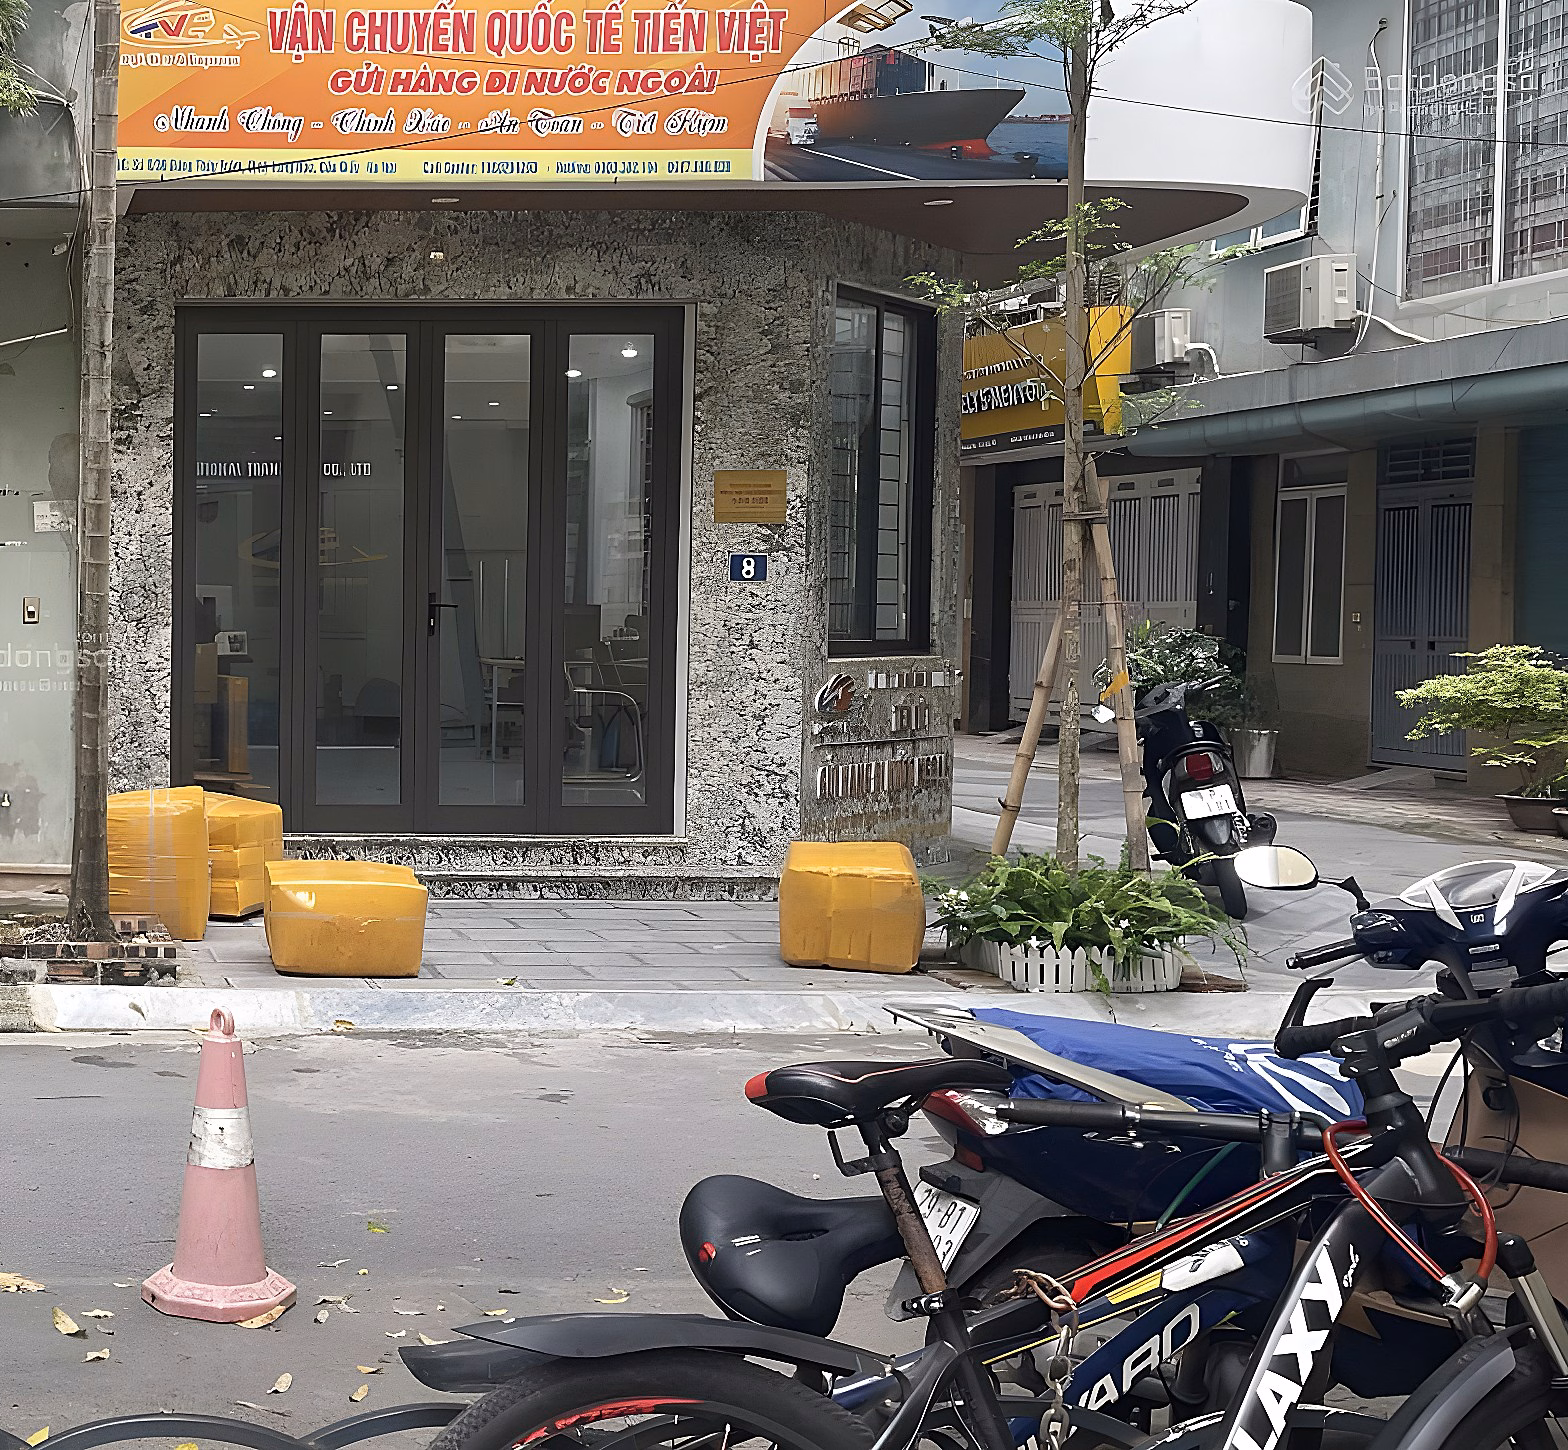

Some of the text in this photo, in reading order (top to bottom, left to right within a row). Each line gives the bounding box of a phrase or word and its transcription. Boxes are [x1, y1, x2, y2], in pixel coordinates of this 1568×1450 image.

[268, 0, 788, 62] VẬN CHUYỂN QUỐC TẾ TIẾN VIỆT
[328, 60, 720, 96] GỬI HÀNG ĐI NƯỚC NGOÀI
[741, 557, 755, 579] 8
